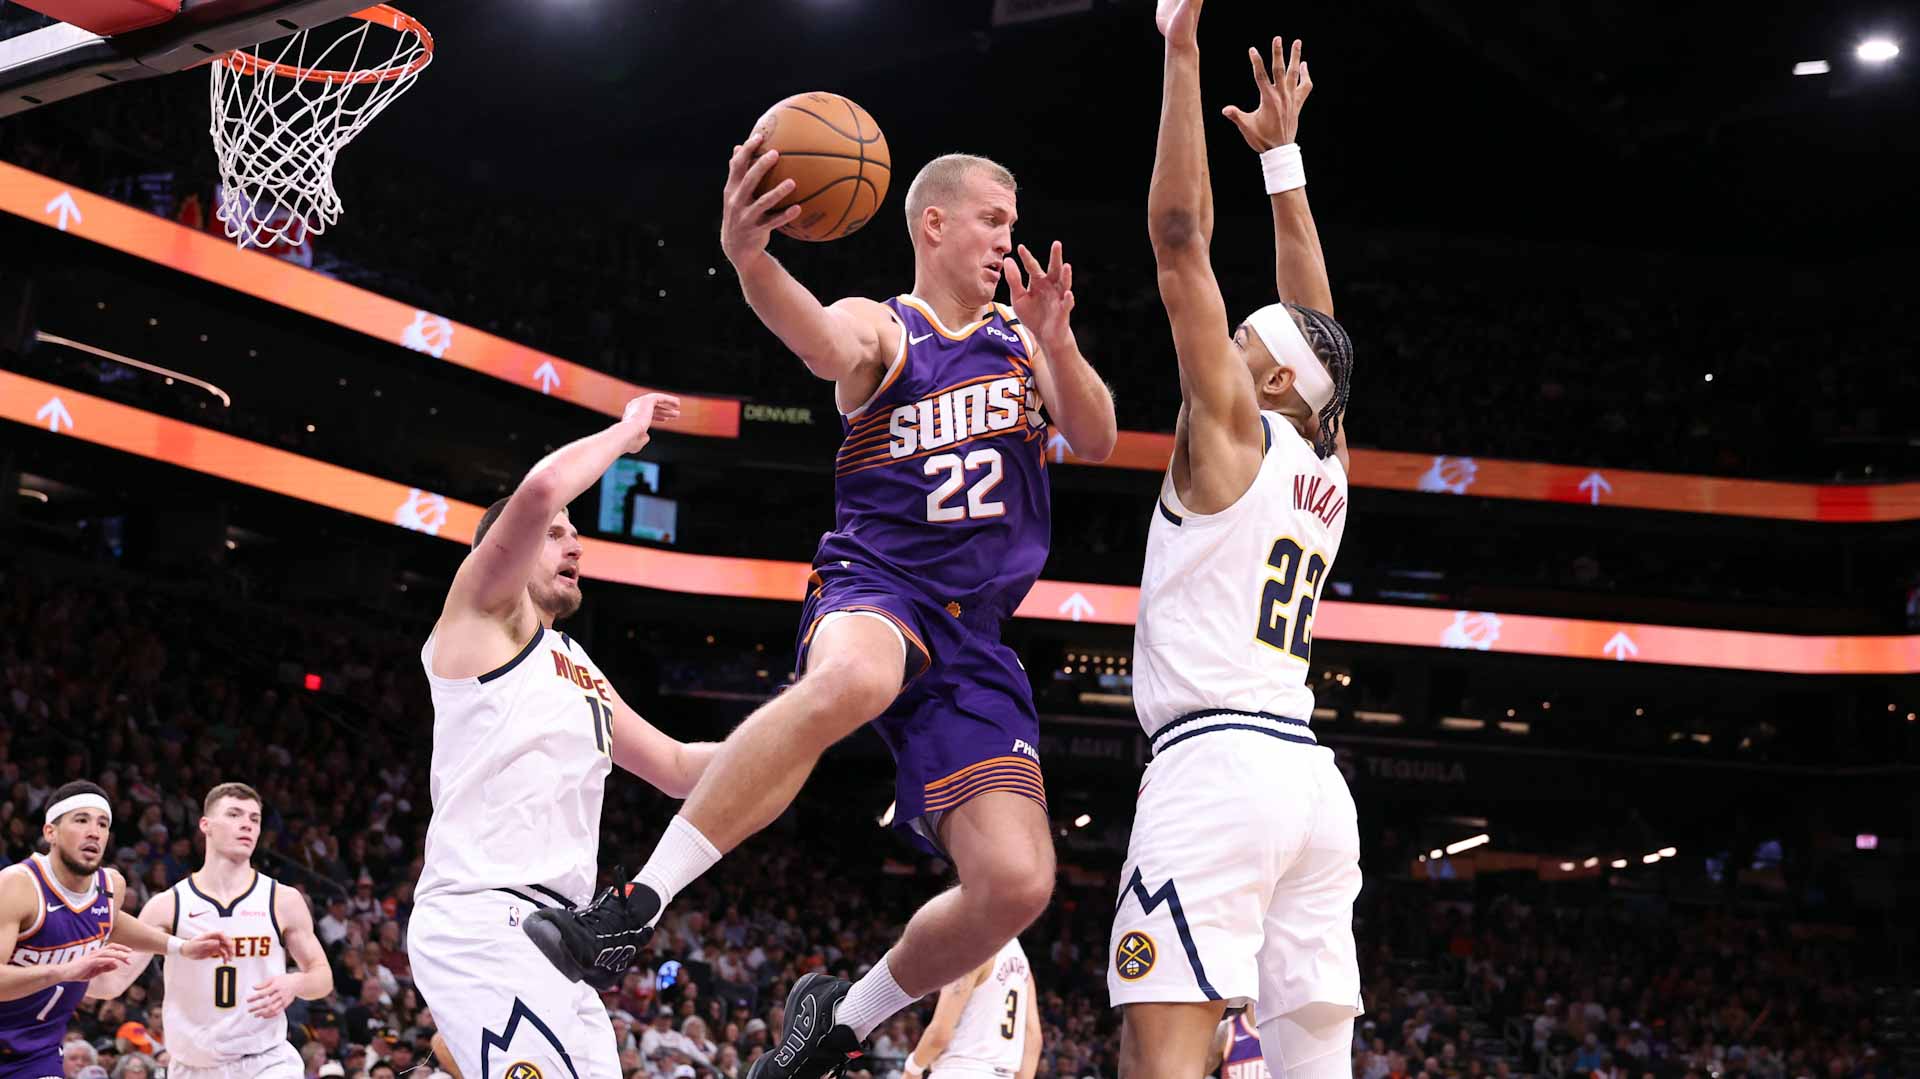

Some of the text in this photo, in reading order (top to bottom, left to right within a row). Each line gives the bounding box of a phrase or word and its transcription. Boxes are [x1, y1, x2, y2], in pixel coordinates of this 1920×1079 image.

[986, 326, 1019, 342] PaPal
[890, 377, 1020, 459] SUNS
[924, 448, 1006, 522] 22
[1293, 474, 1346, 529] NNAJI
[1254, 535, 1328, 665] 22
[1366, 757, 1466, 783] TEQUILA
[36, 985, 64, 1021] 1
[214, 964, 237, 1009] 0
[774, 993, 817, 1068] AIR
[1000, 989, 1018, 1041] 3
